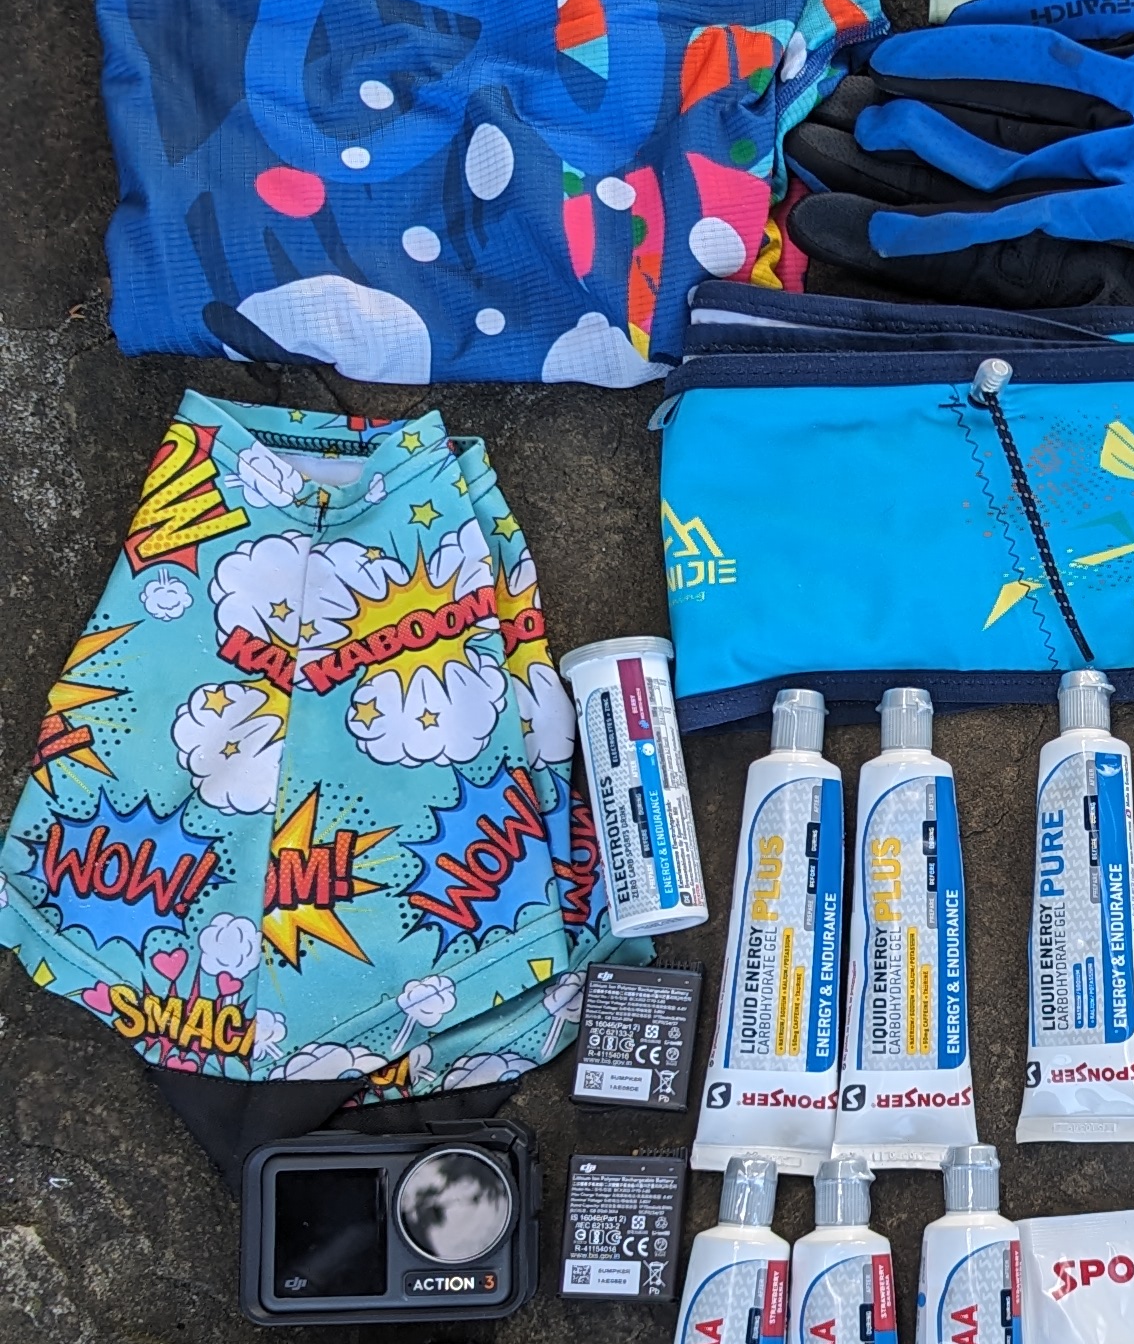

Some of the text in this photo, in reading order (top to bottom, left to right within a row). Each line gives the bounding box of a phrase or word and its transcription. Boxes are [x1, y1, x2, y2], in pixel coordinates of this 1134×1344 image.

[129, 423, 250, 559] OW
[300, 586, 499, 696] KABOOM
[46, 823, 217, 916] WOW!
[600, 776, 630, 904] ELECTROLYTES
[620, 805, 628, 828] DRINK
[623, 829, 633, 857] SPORTS
[649, 790, 673, 894] ENERGY & ENDURANCE
[630, 879, 639, 899] ZERO
[740, 836, 784, 1054] LIQUID ENERGY PLUS
[871, 837, 902, 1055] LIQUID ENERGY PLUS
[1040, 809, 1064, 1030] LIQUID ENERGY PURE
[1109, 863, 1127, 1028] ENERGY & ENDURANCE
[757, 927, 777, 1055] CARBOHYDRATE GEL
[816, 893, 837, 1057] ENERGY & ENDURANCE
[889, 926, 902, 1055] CARBOHYDRATE GEL
[946, 889, 960, 1054] ENERGY & ENDURANCE
[1055, 902, 1069, 1030] CARBOHYDRATE GEL
[876, 1087, 972, 1108] SPONSER
[413, 1276, 495, 1291] ACTION 3
